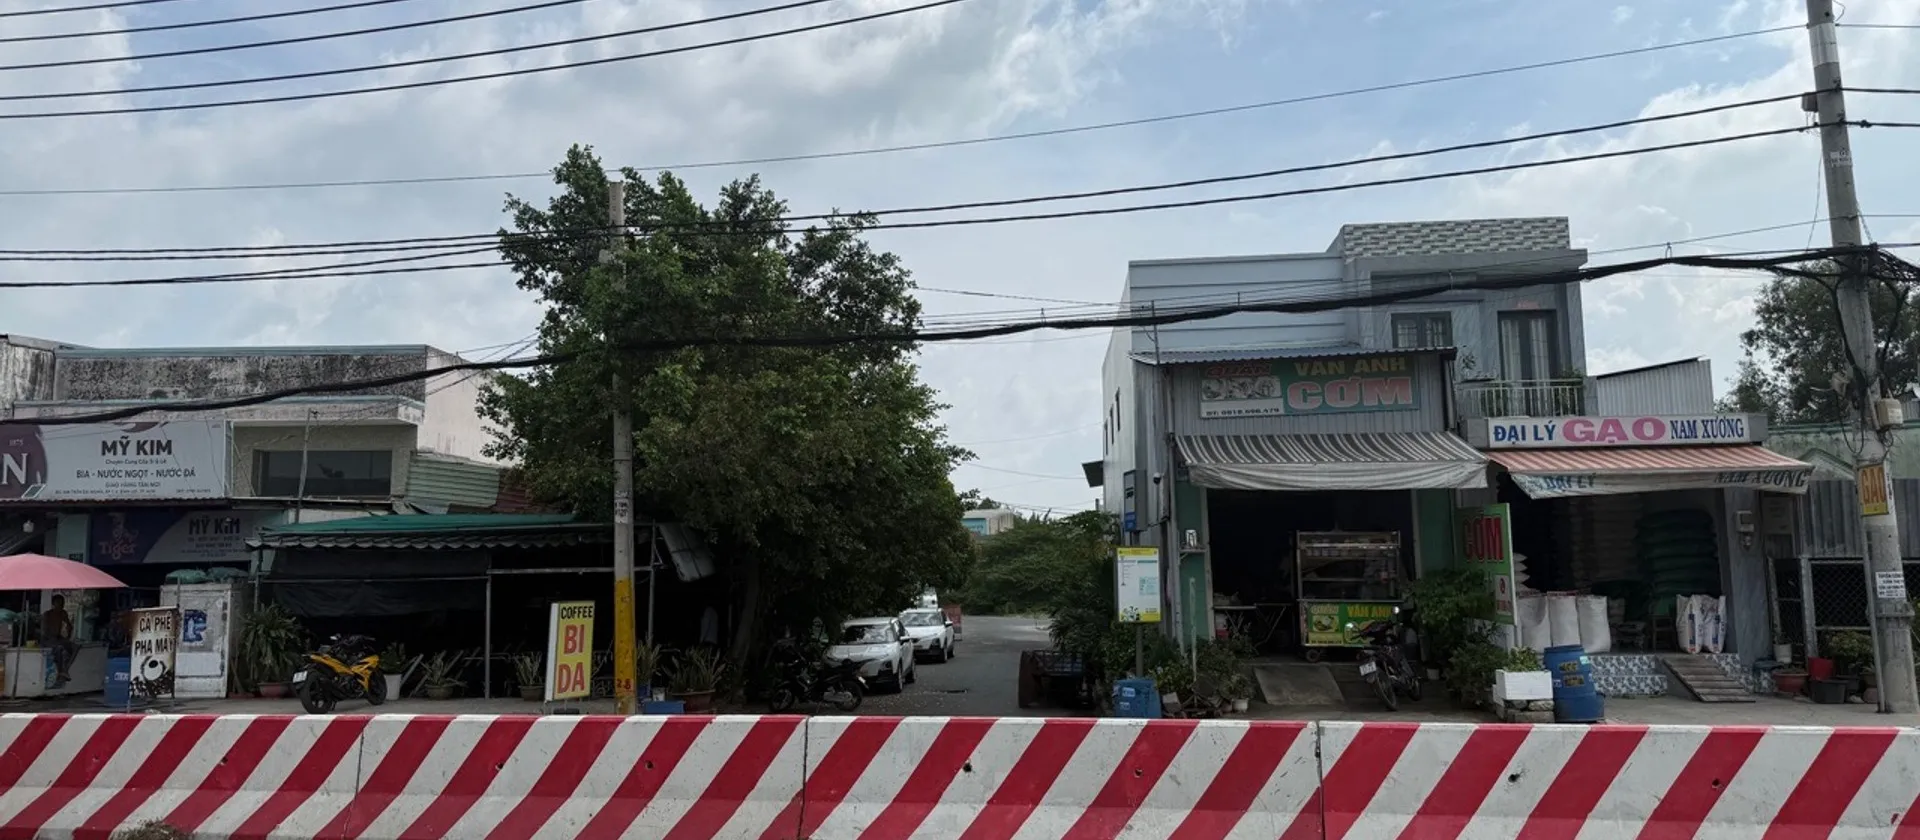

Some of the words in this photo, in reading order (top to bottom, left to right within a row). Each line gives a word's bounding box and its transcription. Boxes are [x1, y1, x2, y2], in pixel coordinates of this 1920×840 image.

[1353, 356, 1406, 373] ANH
[1286, 376, 1413, 410] CƠM
[1493, 424, 1526, 445] ĐẠI
[1533, 420, 1556, 441] LÝ
[1562, 417, 1666, 444] GẠO
[1669, 419, 1698, 439] NAM
[101, 435, 131, 456] MỸ
[136, 439, 172, 456] KIM
[76, 469, 90, 479] BIA
[97, 467, 123, 479] NƯỚC
[124, 469, 149, 481] NGỌT
[156, 466, 181, 478] NƯỚC
[183, 466, 196, 478] ĐÁ
[97, 540, 137, 561] Tiger
[560, 605, 594, 620] COFFEE
[134, 638, 153, 656] PHA
[563, 624, 585, 655] BI
[556, 662, 585, 694] DA
